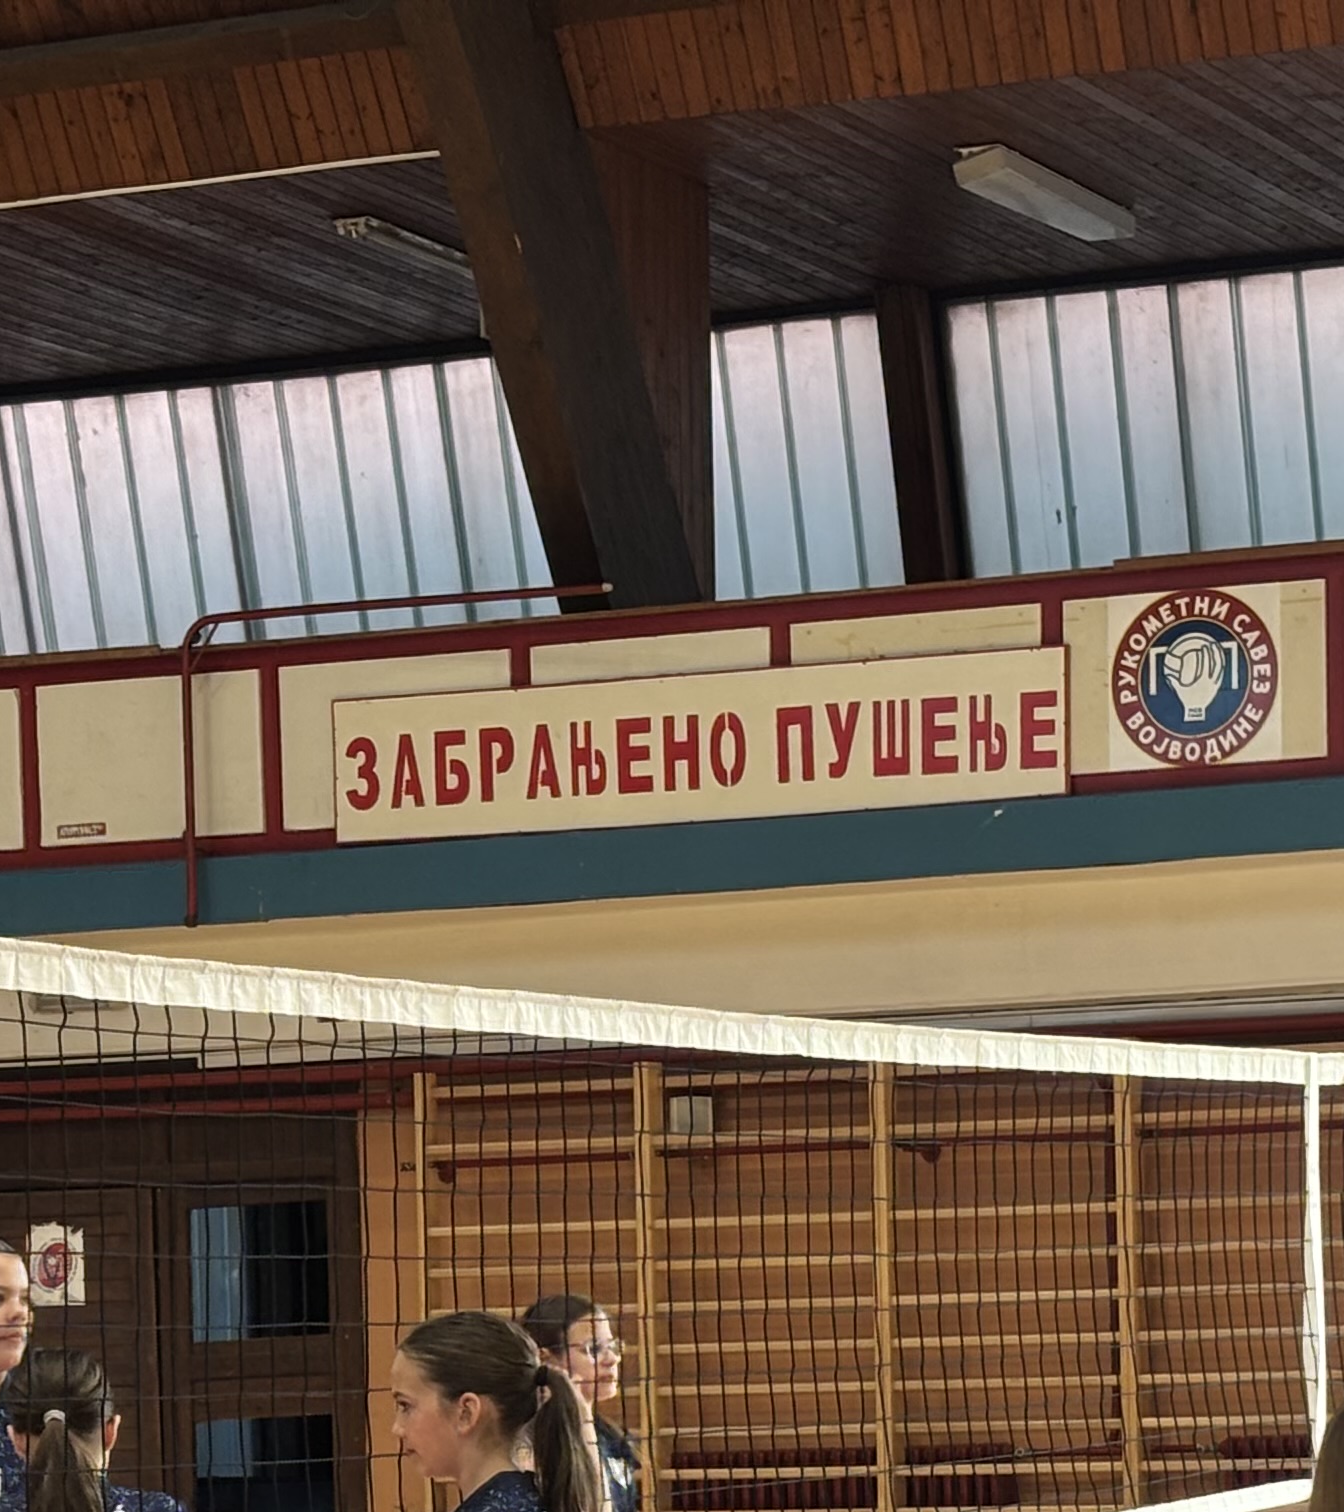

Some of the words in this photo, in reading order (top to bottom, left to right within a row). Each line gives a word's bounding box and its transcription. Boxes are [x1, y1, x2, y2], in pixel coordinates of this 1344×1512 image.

[1118, 596, 1231, 705] РУКОМЕТНИ
[1232, 614, 1272, 695] САВЕЗ
[345, 711, 746, 811] ЗАБРАЊЕНО
[776, 690, 1058, 784] ПУШЕЊЕ
[1126, 703, 1264, 765] ВОЈВОДИНЕ
